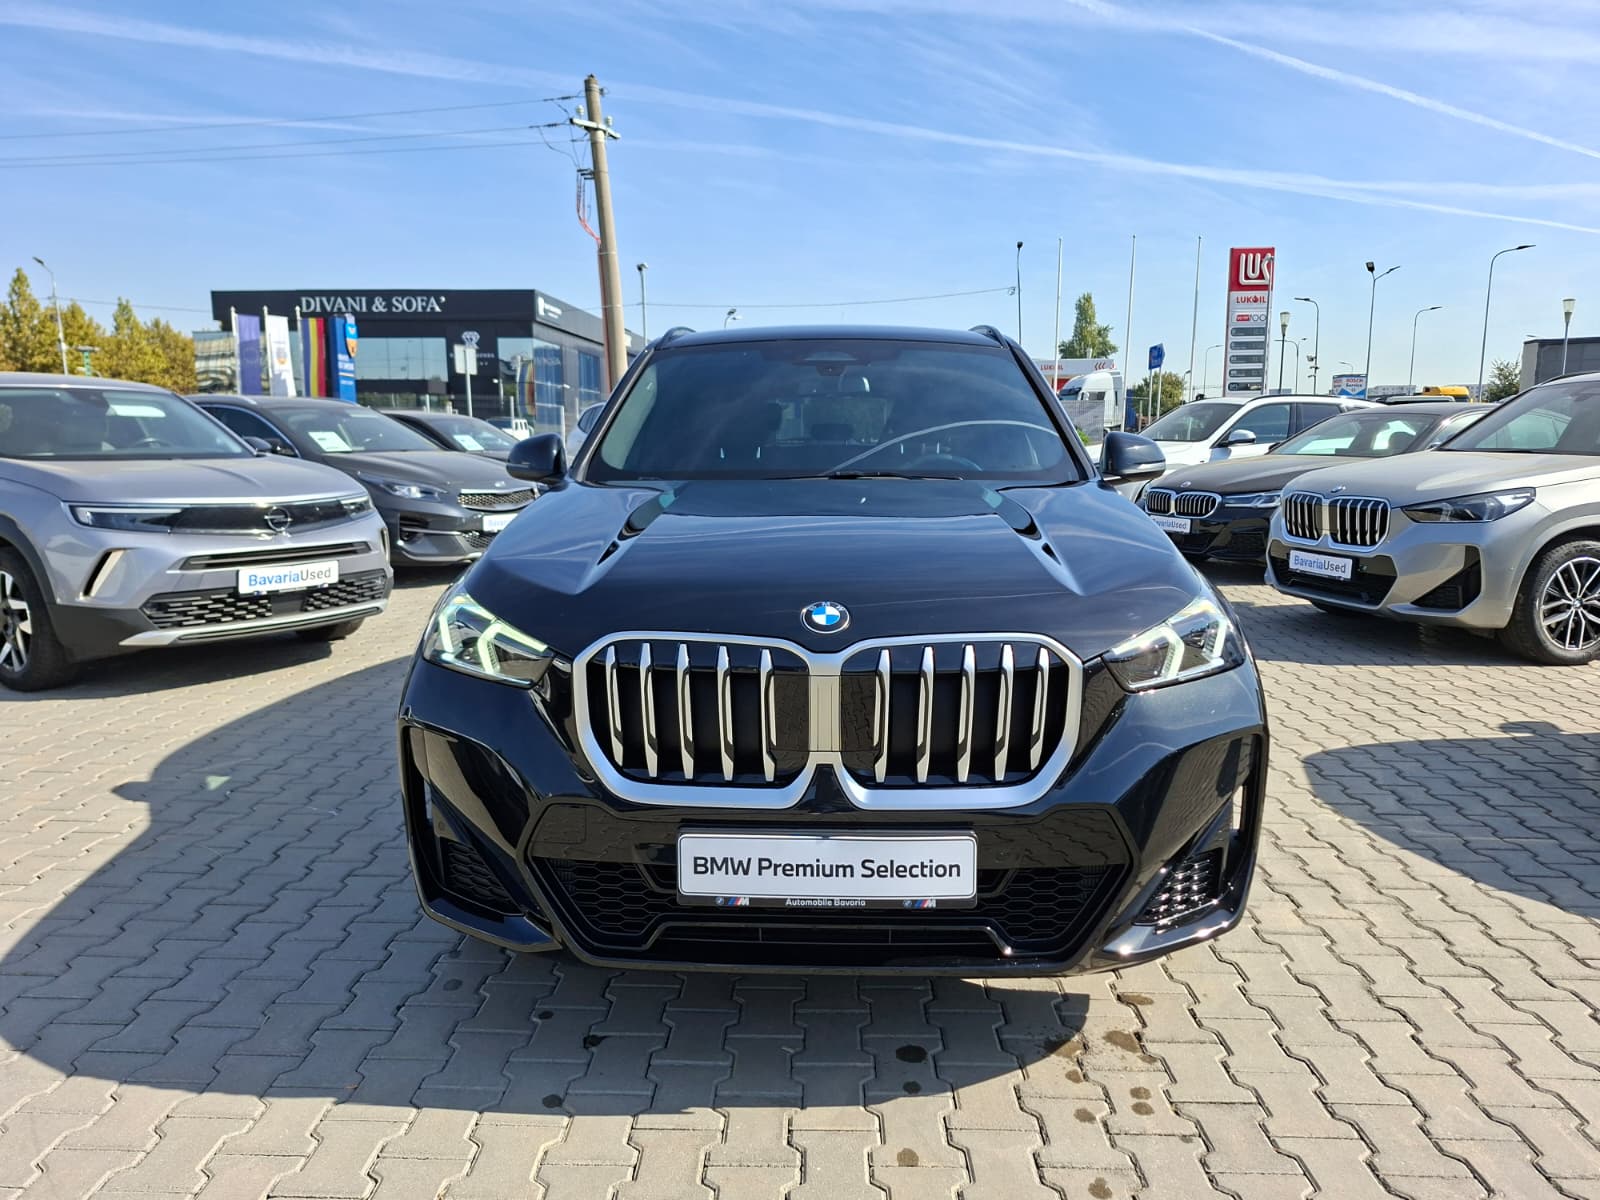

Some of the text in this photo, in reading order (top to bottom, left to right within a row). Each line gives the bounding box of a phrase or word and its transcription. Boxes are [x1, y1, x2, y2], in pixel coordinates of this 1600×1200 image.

[301, 296, 368, 313] DIVANI
[371, 296, 388, 313] &
[1293, 554, 1348, 575] BavariaUsed
[247, 567, 333, 588] BavariaUsed
[692, 856, 962, 879] BMW Premium Selection
[785, 898, 867, 907] Automobile Bavaria
